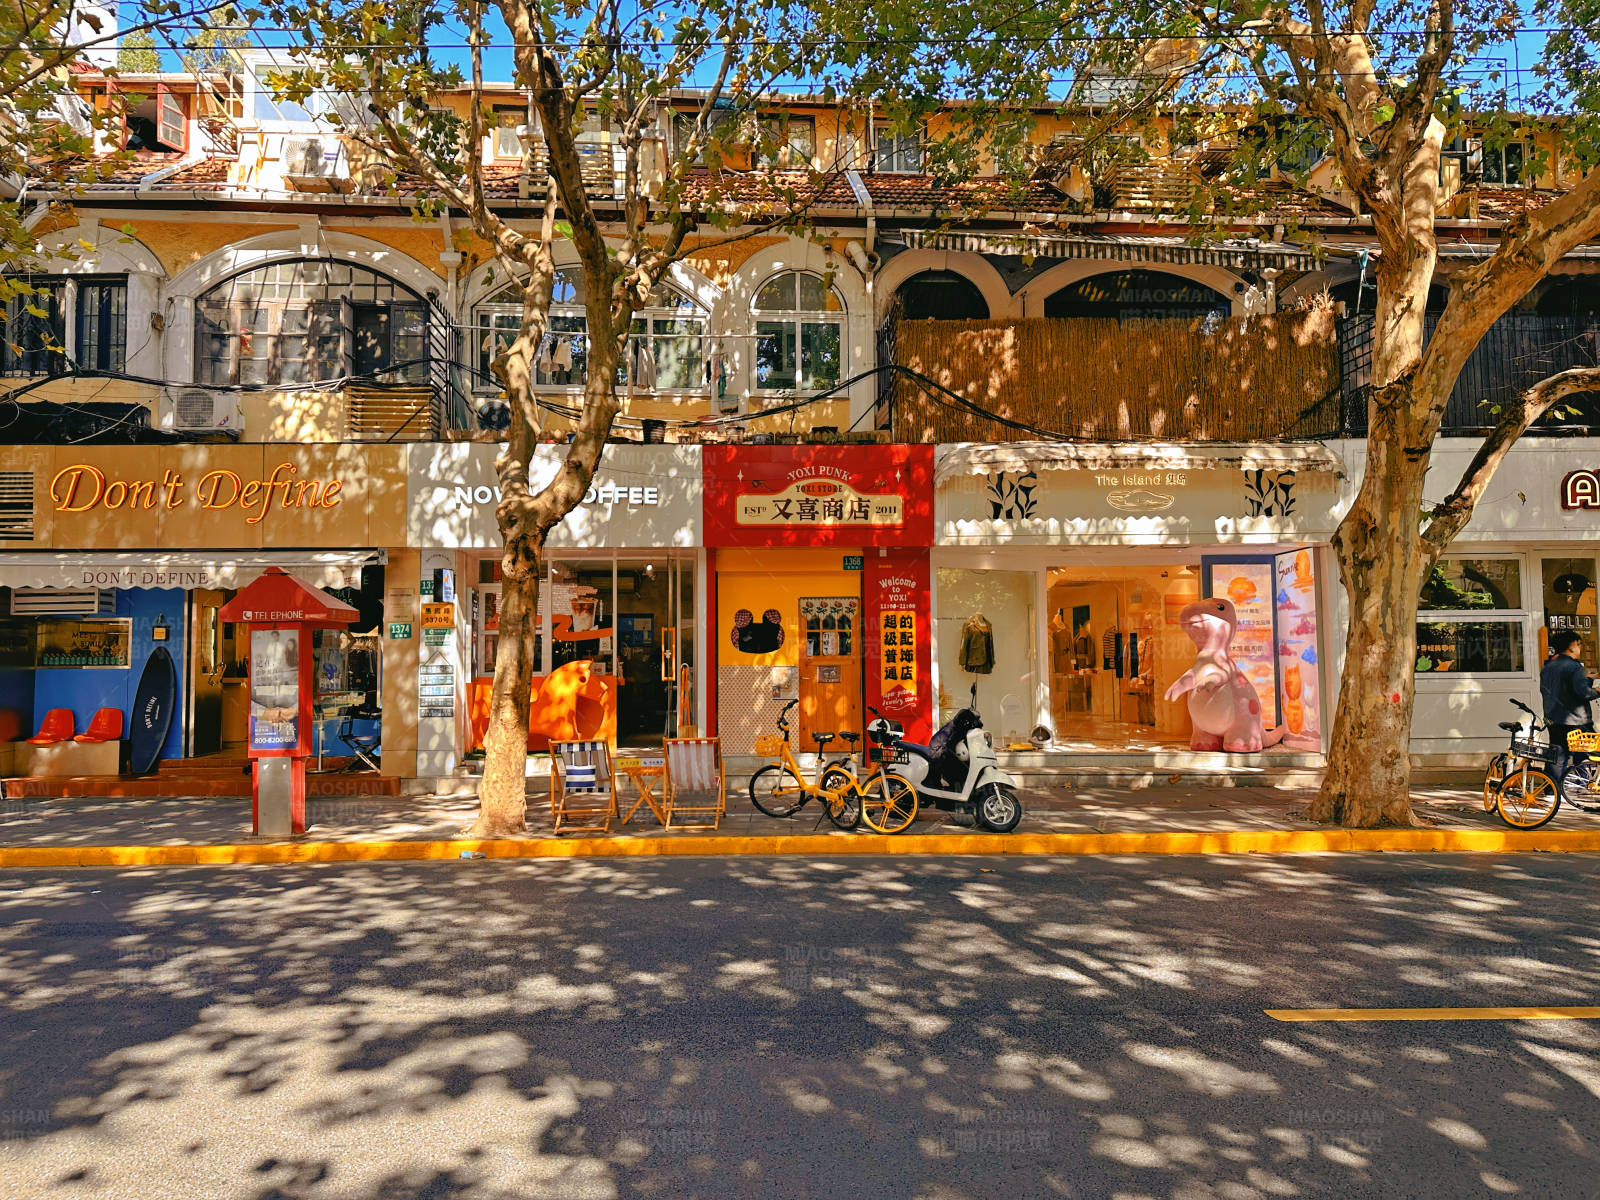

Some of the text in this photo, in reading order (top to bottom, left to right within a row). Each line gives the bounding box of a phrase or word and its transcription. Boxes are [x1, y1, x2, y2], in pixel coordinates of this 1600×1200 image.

[788, 465, 850, 482] YOXI PUNK
[1095, 474, 1119, 486] The
[1122, 473, 1161, 486] Island
[50, 461, 344, 524] Don't Define
[454, 485, 658, 505] NO OFFEE
[796, 485, 843, 493] YOXI STORE
[1562, 470, 1600, 511] A
[770, 497, 871, 521] 又喜商店
[875, 505, 897, 514] 2011
[82, 571, 209, 585] DON'T DEFINE
[879, 576, 917, 588] Welcome
[391, 624, 410, 634] 1374
[1549, 615, 1592, 629] HELLO
[883, 614, 898, 681] 超级普通
[899, 614, 914, 681] 的配饰店
